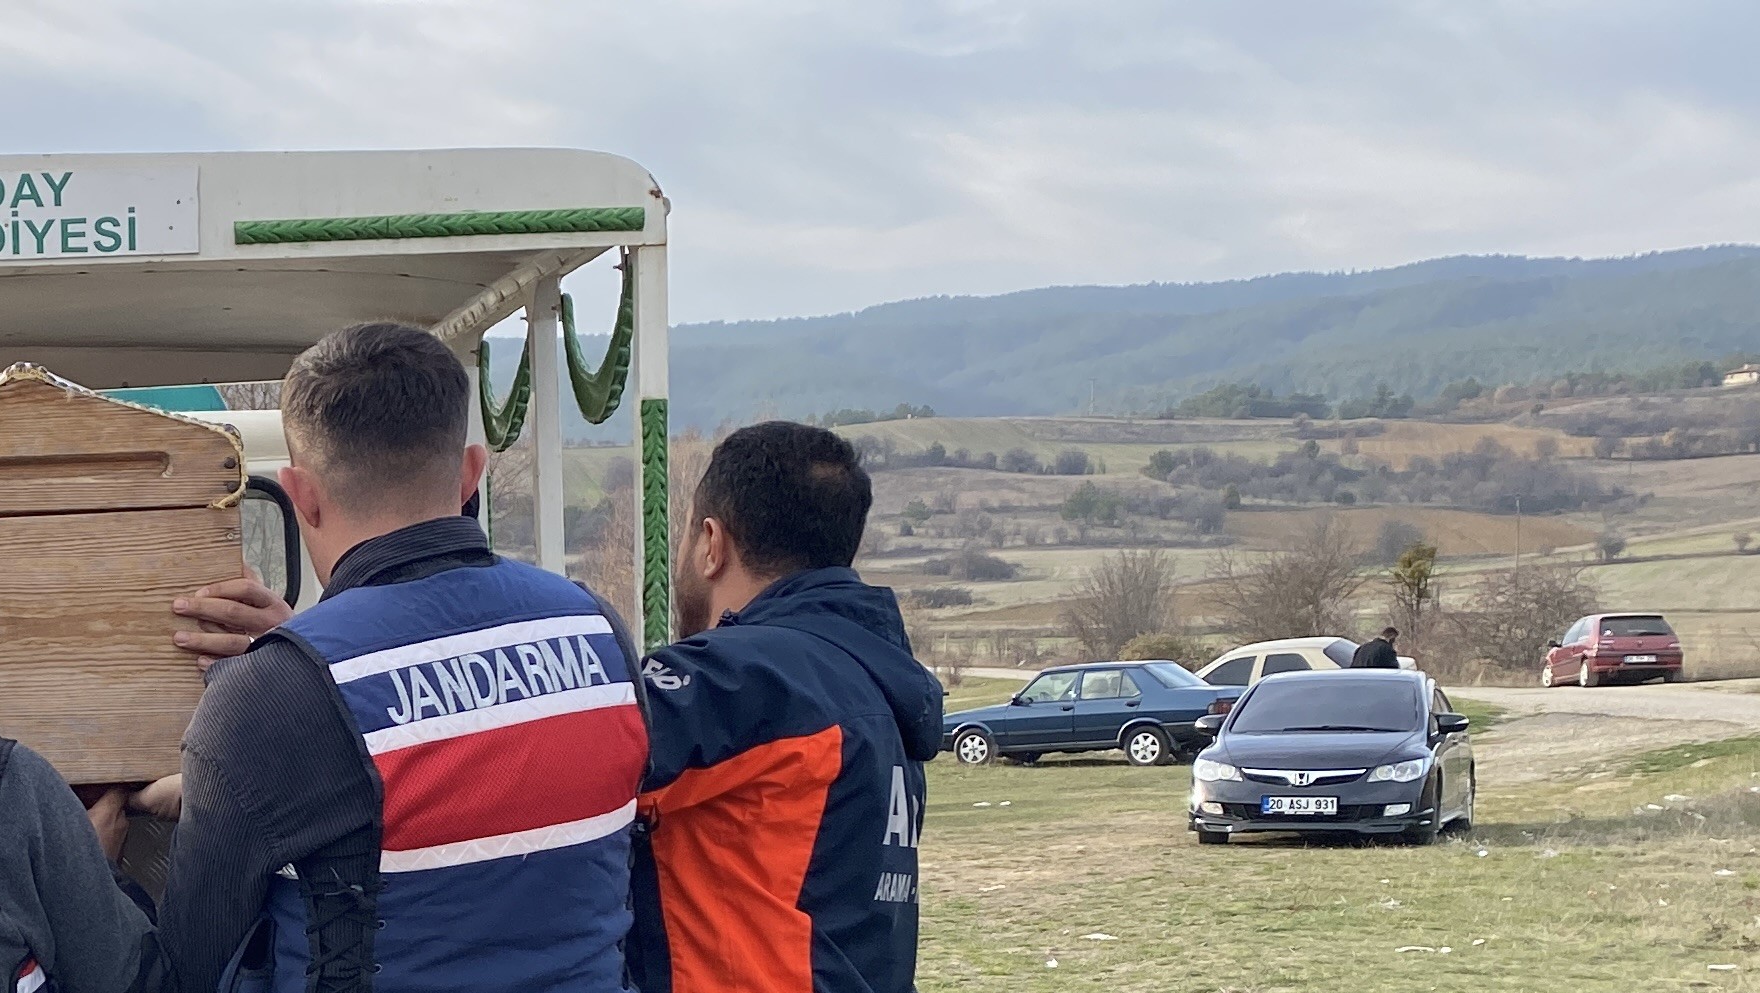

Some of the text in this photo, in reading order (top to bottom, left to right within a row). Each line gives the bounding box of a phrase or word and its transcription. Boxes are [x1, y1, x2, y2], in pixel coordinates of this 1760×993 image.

[386, 634, 611, 725] JANDARMA
[1269, 799, 1335, 810] 20 ASJ 931
